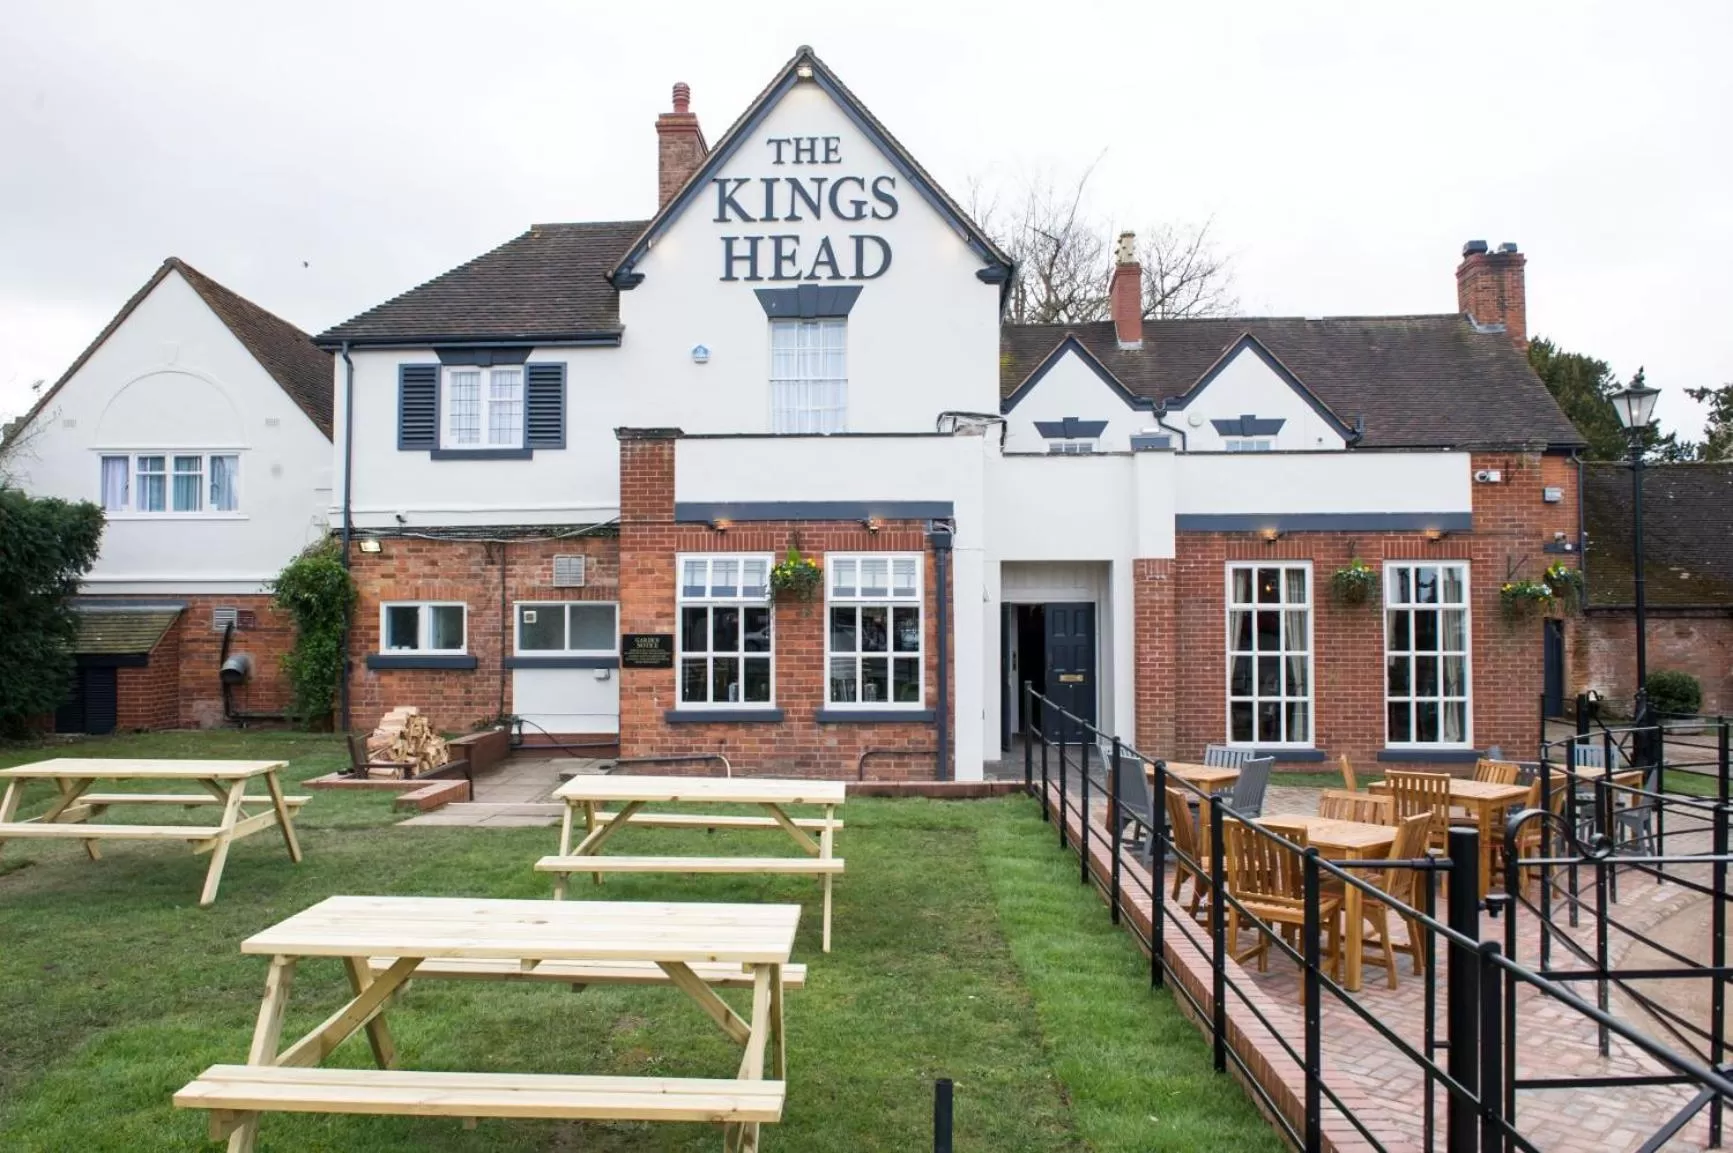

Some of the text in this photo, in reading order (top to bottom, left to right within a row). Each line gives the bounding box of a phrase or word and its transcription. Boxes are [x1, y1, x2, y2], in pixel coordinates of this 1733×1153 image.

[767, 137, 842, 164] THE
[712, 176, 899, 223] KINGS
[719, 235, 893, 282] HEAD
